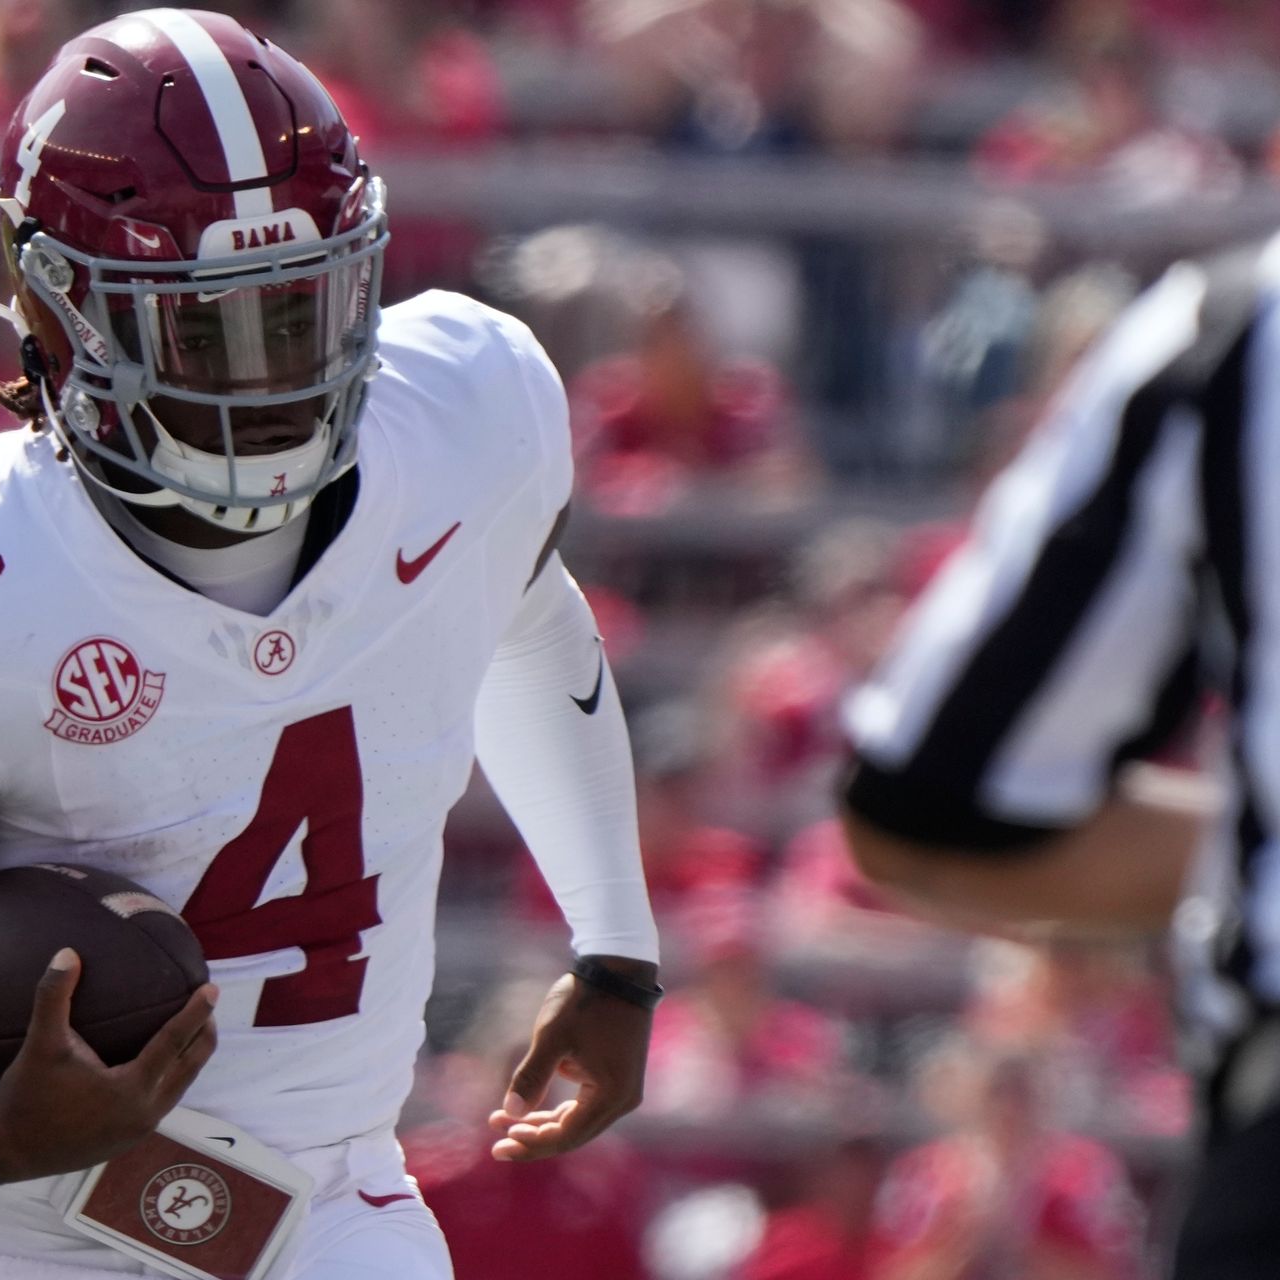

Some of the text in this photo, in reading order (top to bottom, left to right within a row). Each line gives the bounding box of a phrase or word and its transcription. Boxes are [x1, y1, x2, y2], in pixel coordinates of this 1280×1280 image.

[15, 98, 66, 208] 4
[231, 221, 296, 250] BAMA
[58, 640, 140, 720] SEC
[65, 697, 157, 745] GRADUATE
[181, 704, 382, 1027] 4
[145, 1196, 215, 1241] ALABAMA
